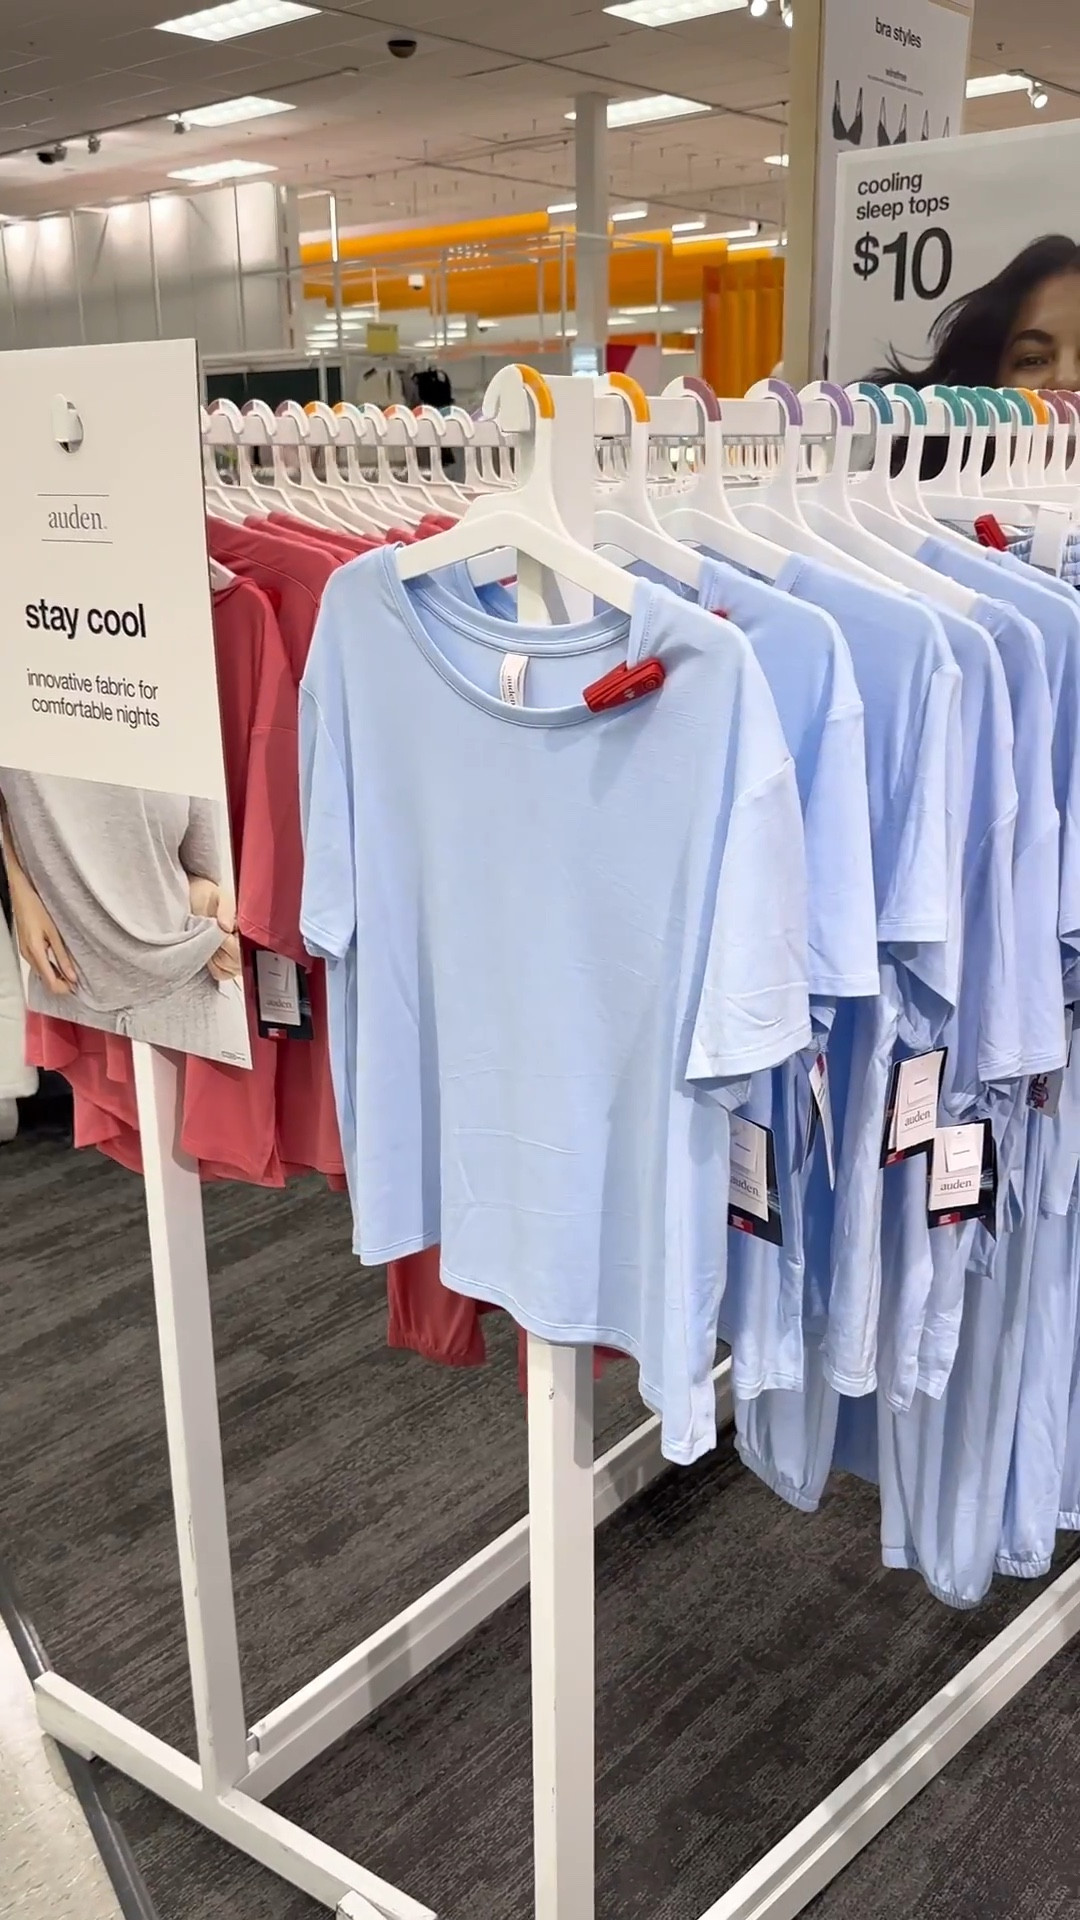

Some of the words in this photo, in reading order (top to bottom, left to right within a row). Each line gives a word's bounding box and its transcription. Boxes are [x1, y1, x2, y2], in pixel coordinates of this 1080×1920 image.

[876, 16, 892, 38] bra
[893, 26, 921, 49] styles
[857, 172, 922, 195] cooling
[856, 200, 904, 221] sleep
[908, 196, 950, 217] tops
[852, 226, 953, 302] $10
[25, 598, 79, 640] stay
[87, 602, 147, 638] cool
[26, 667, 93, 694] innovative
[95, 675, 136, 699] fabric
[138, 679, 159, 700] for
[31, 697, 113, 722] comfortable
[116, 704, 160, 730] nights
[904, 1108, 931, 1127] auden
[940, 1179, 972, 1191] auden
